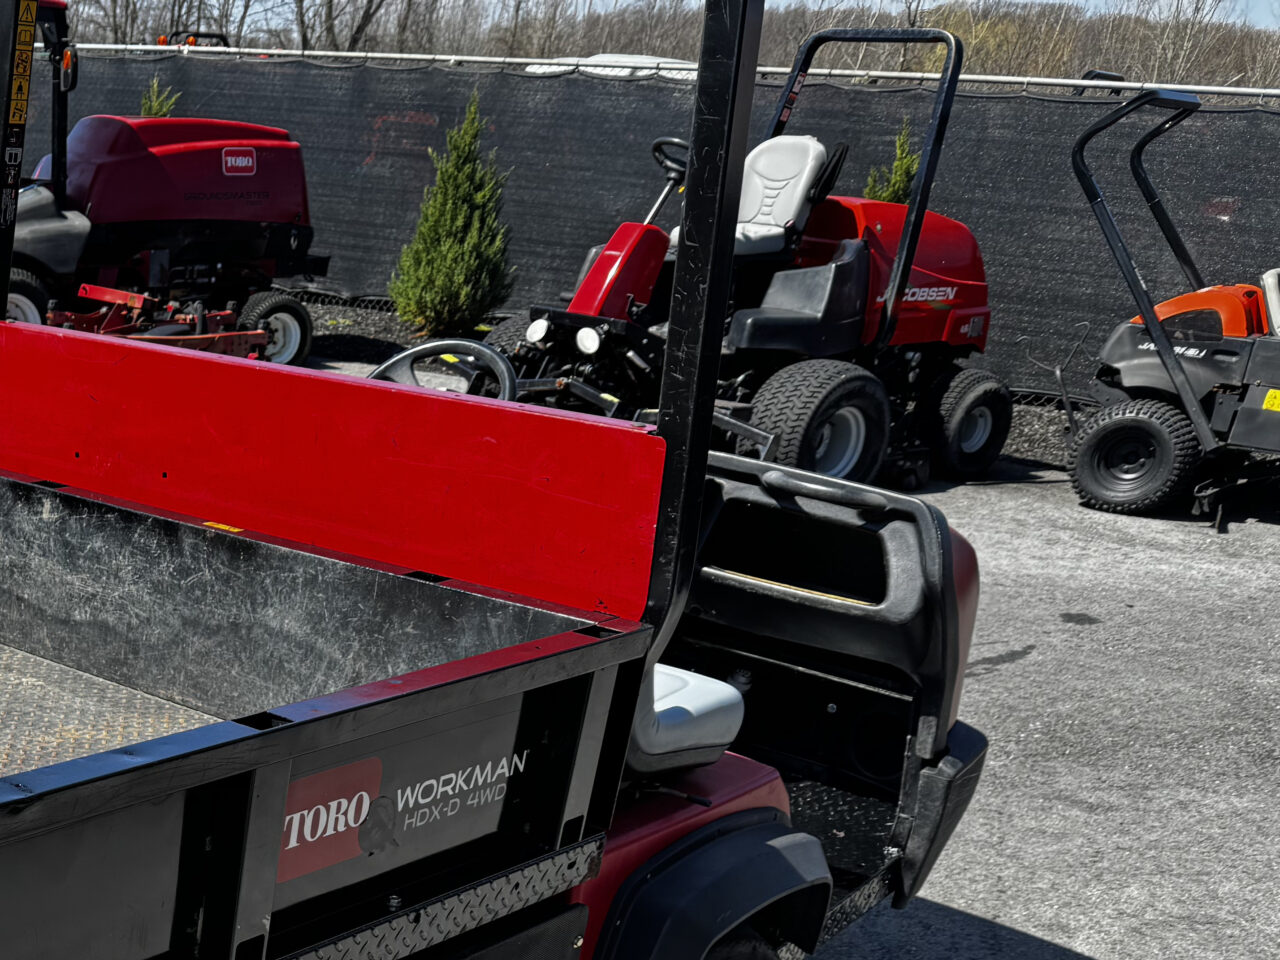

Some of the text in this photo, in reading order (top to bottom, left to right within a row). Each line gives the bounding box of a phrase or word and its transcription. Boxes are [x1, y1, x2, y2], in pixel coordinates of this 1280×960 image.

[225, 156, 253, 167] TORO
[397, 750, 528, 812] WORKMAN
[404, 783, 507, 832] HDX-D 4WD
[284, 791, 370, 850] TORO
